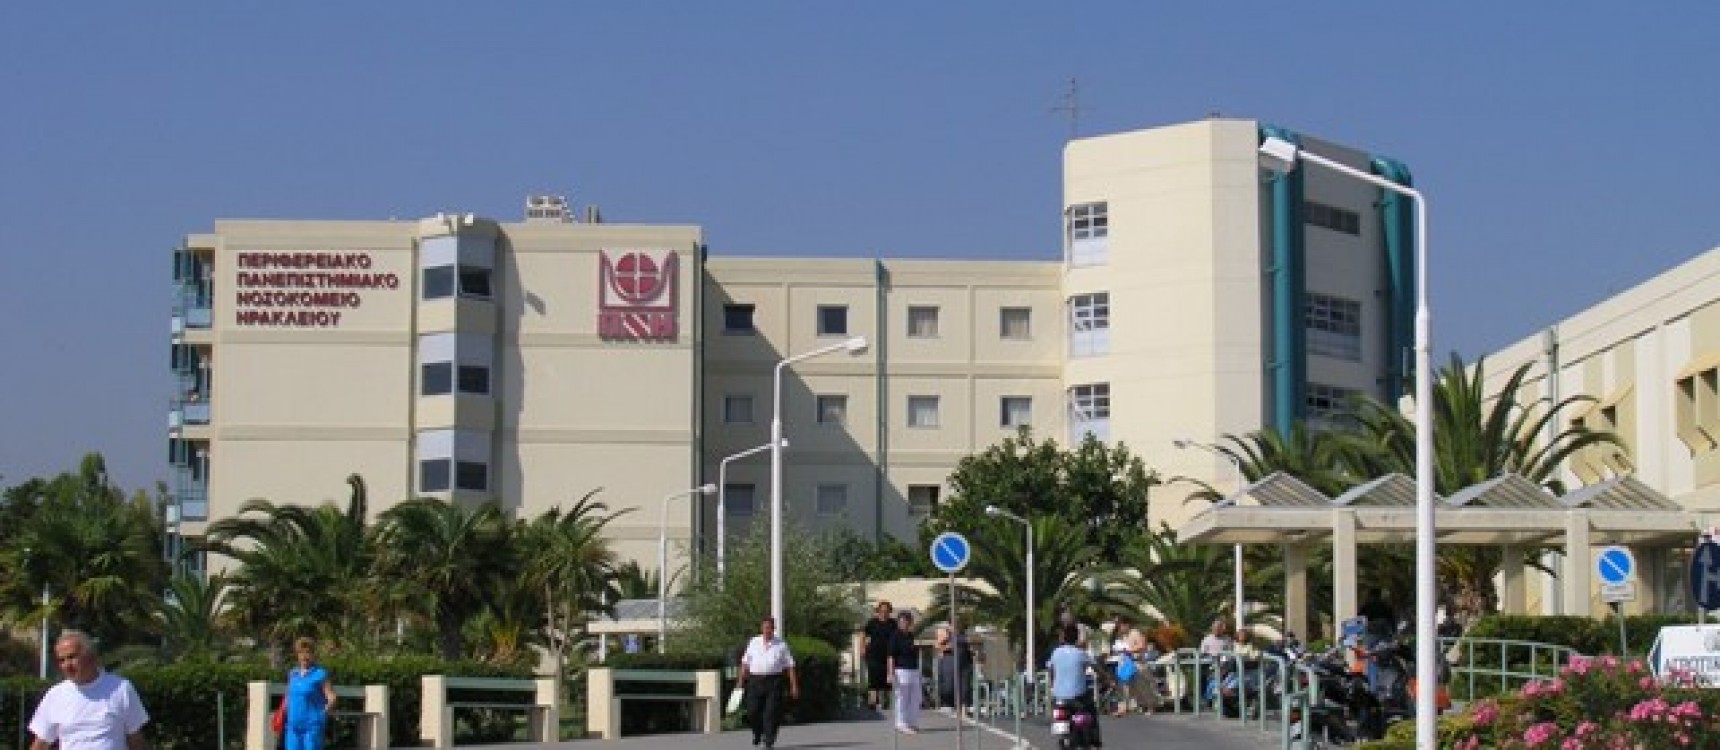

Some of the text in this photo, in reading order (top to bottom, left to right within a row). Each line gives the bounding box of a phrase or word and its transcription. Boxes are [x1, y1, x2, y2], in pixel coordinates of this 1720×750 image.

[237, 252, 372, 269] ΠΕΡΙΦΕΡΕΙΑΚΟ
[237, 272, 399, 289] ΠΑΝΕΠΙΣΤΗΜΙΑΚΟ
[236, 291, 361, 309] ΝΟΣΟΚΟΜΕΙΟ
[236, 311, 341, 327] ΗΡΑΚΛΕΙΟΥ
